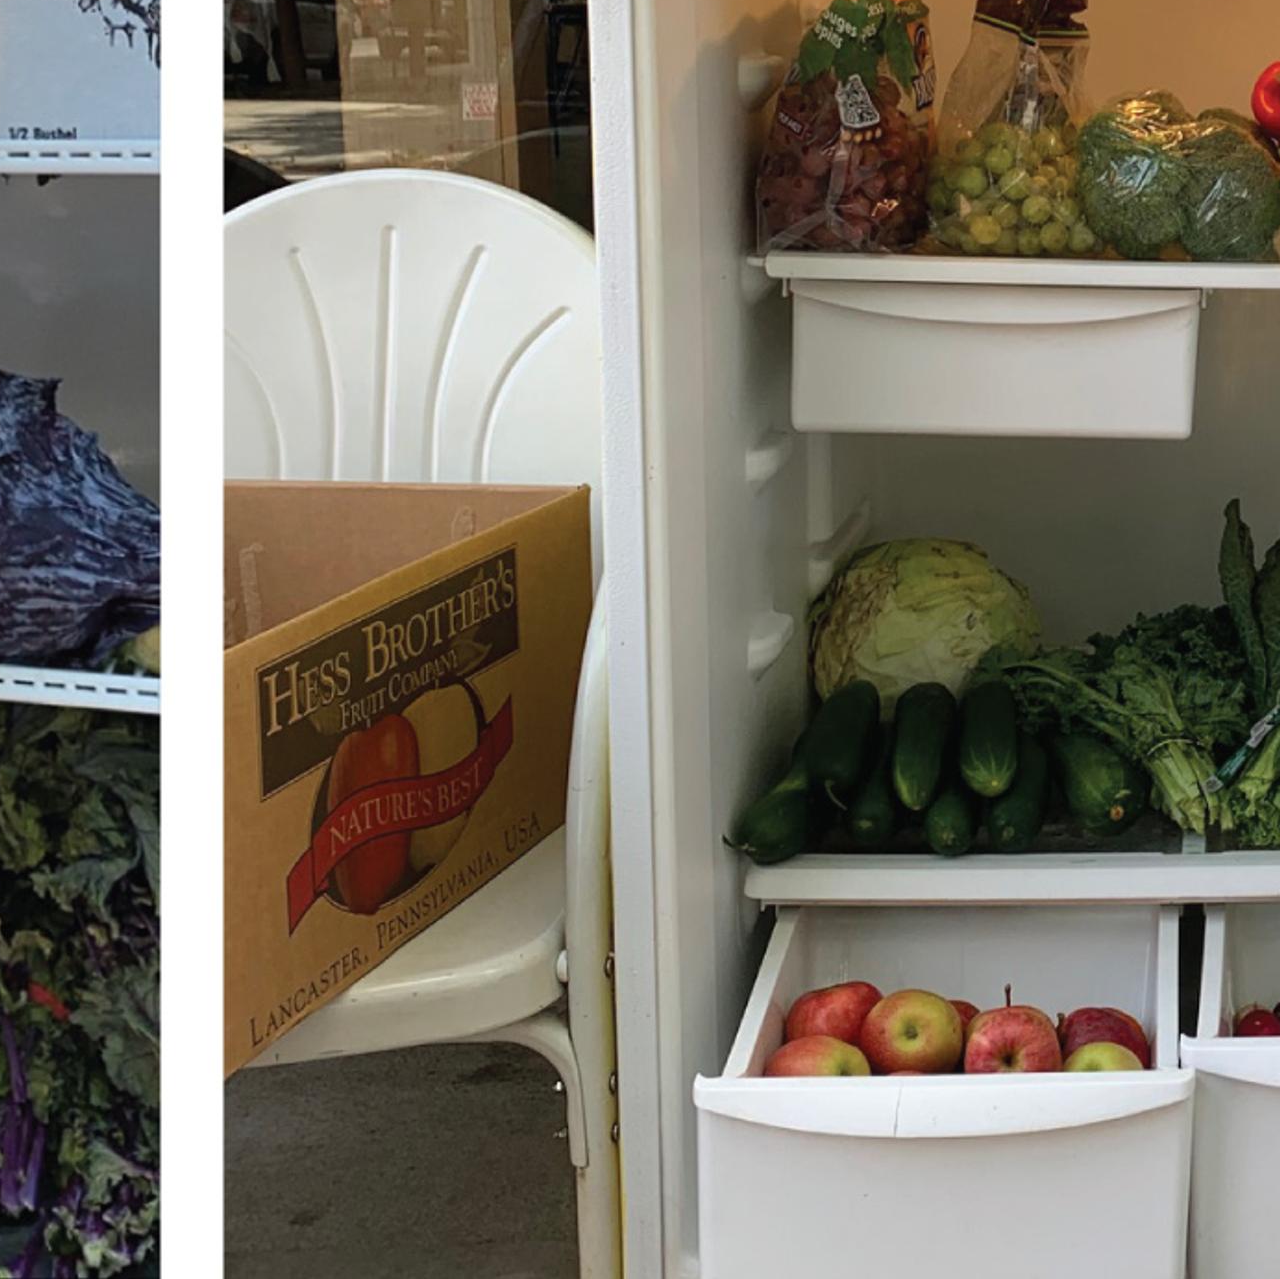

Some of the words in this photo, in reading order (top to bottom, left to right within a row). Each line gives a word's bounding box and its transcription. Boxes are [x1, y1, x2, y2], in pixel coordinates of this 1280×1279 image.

[263, 651, 351, 736] HESS
[362, 559, 515, 682] BROTHER'S
[339, 686, 387, 730] FRUIT
[388, 649, 459, 702] COMPANY
[329, 790, 433, 857] NATURE'S
[437, 757, 483, 813] BEST
[249, 947, 369, 1048] LANCASTER,
[375, 851, 500, 950] PENNSYLVANIA,
[504, 811, 542, 853] USA
